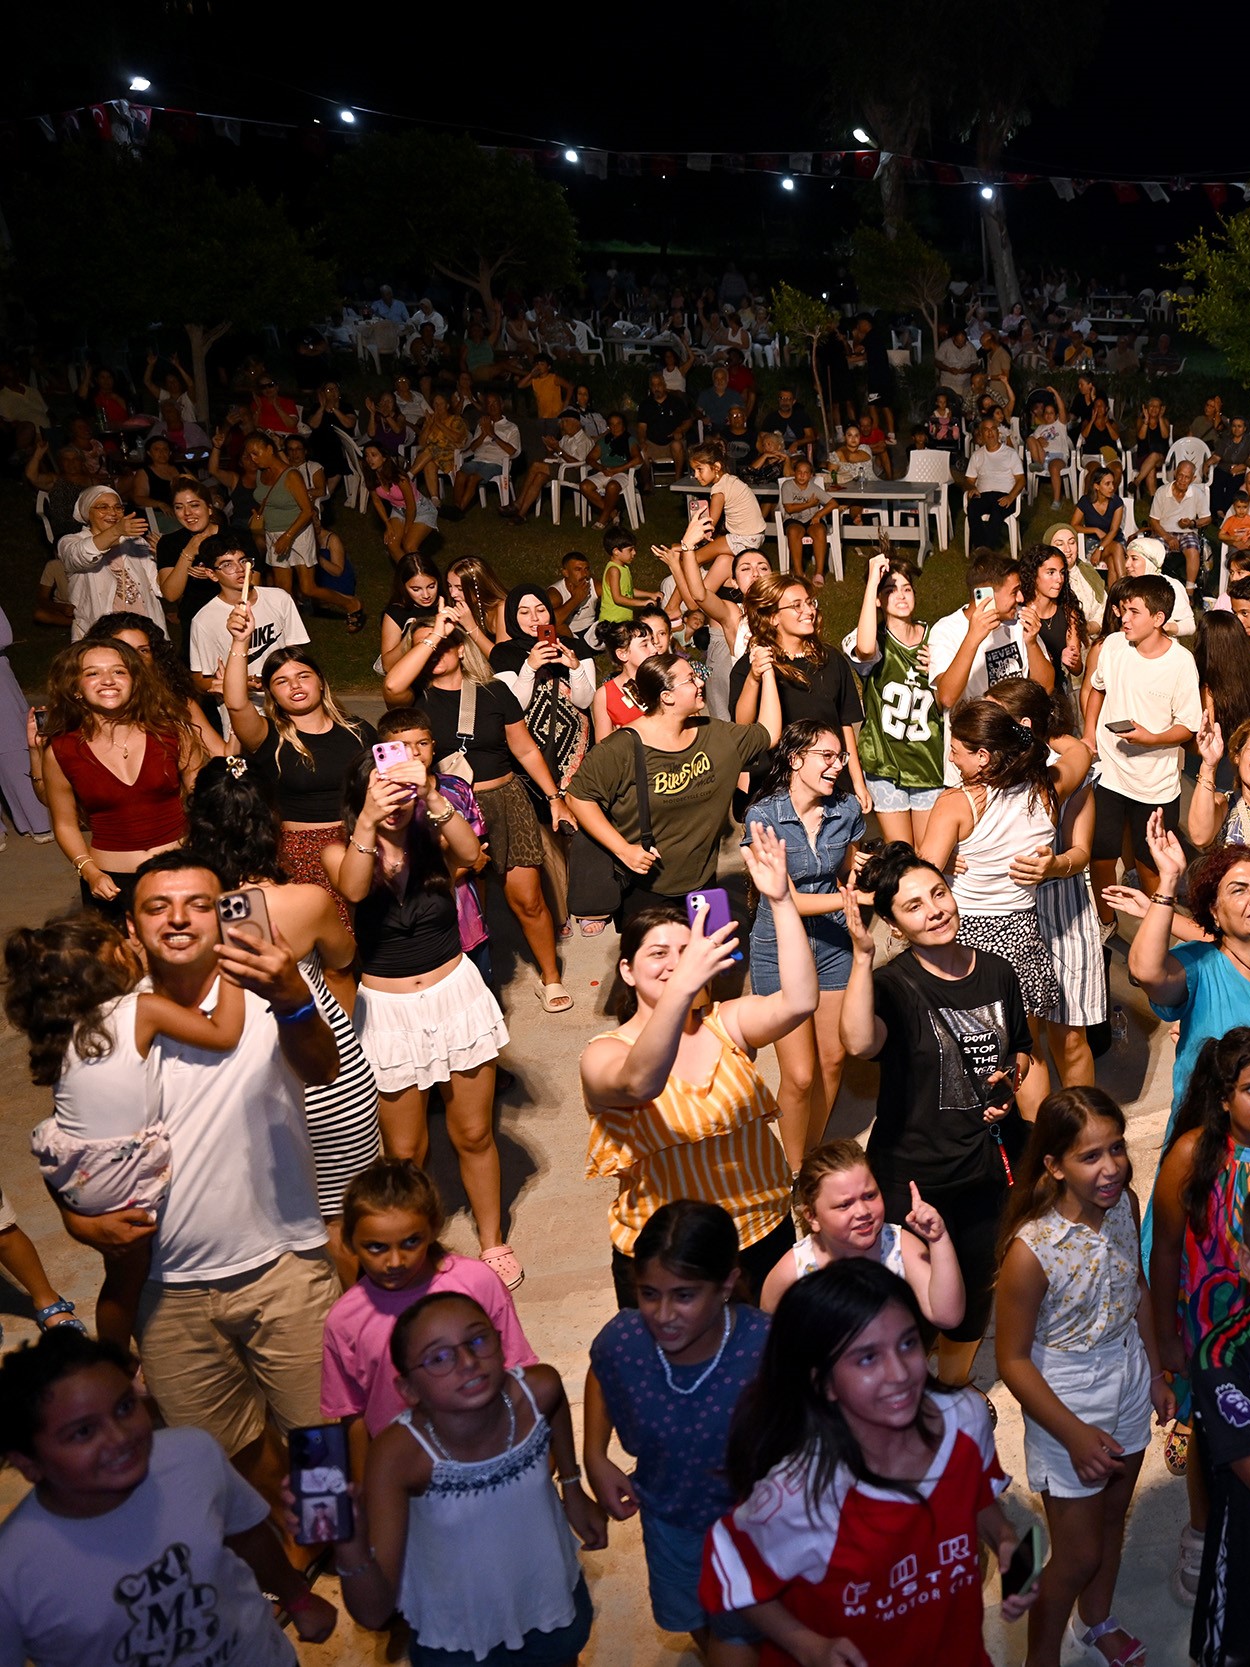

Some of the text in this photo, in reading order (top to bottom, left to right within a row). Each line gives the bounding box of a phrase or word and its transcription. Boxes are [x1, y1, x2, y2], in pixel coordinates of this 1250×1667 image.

[963, 1044, 996, 1054] STOP
[973, 1055, 999, 1065] THE
[842, 1533, 972, 1605] FOR
[949, 1574, 975, 1594] CIT
